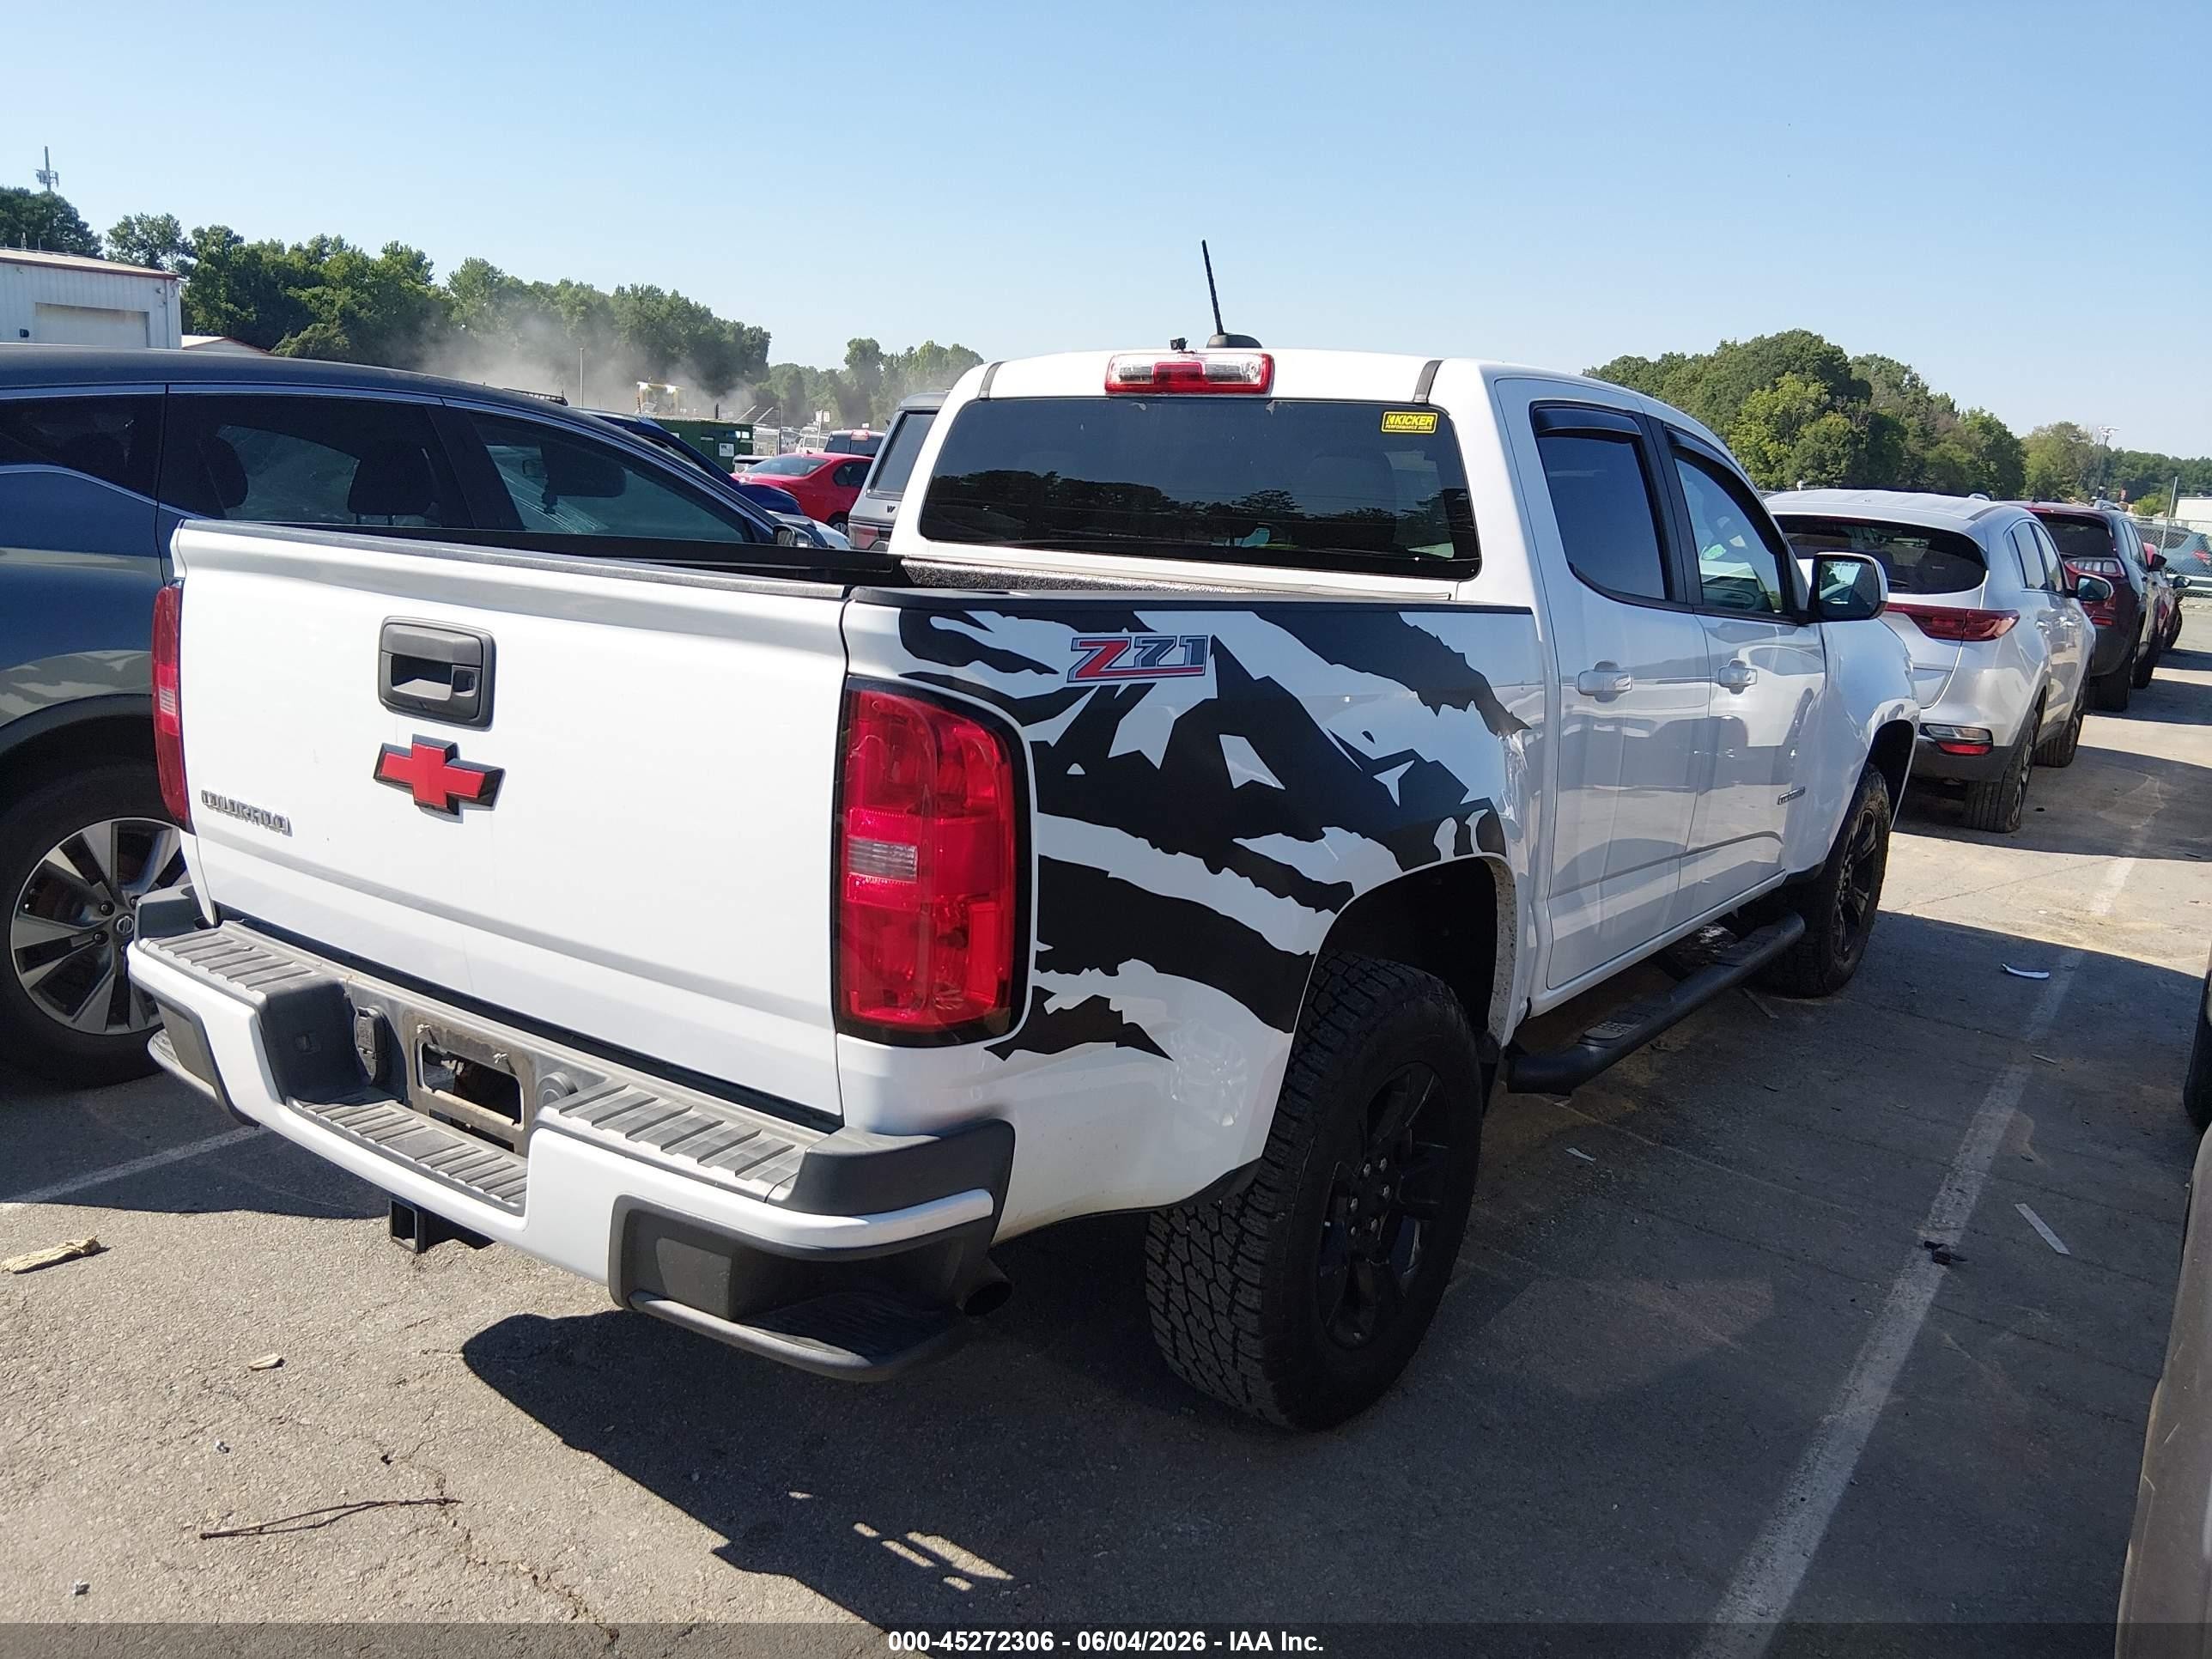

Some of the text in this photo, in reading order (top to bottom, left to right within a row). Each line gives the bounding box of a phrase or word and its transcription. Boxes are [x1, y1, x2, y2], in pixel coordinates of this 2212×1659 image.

[1394, 415, 1435, 426] KICKER
[1066, 635, 1209, 684] Z71
[201, 789, 293, 837] COLORADO
